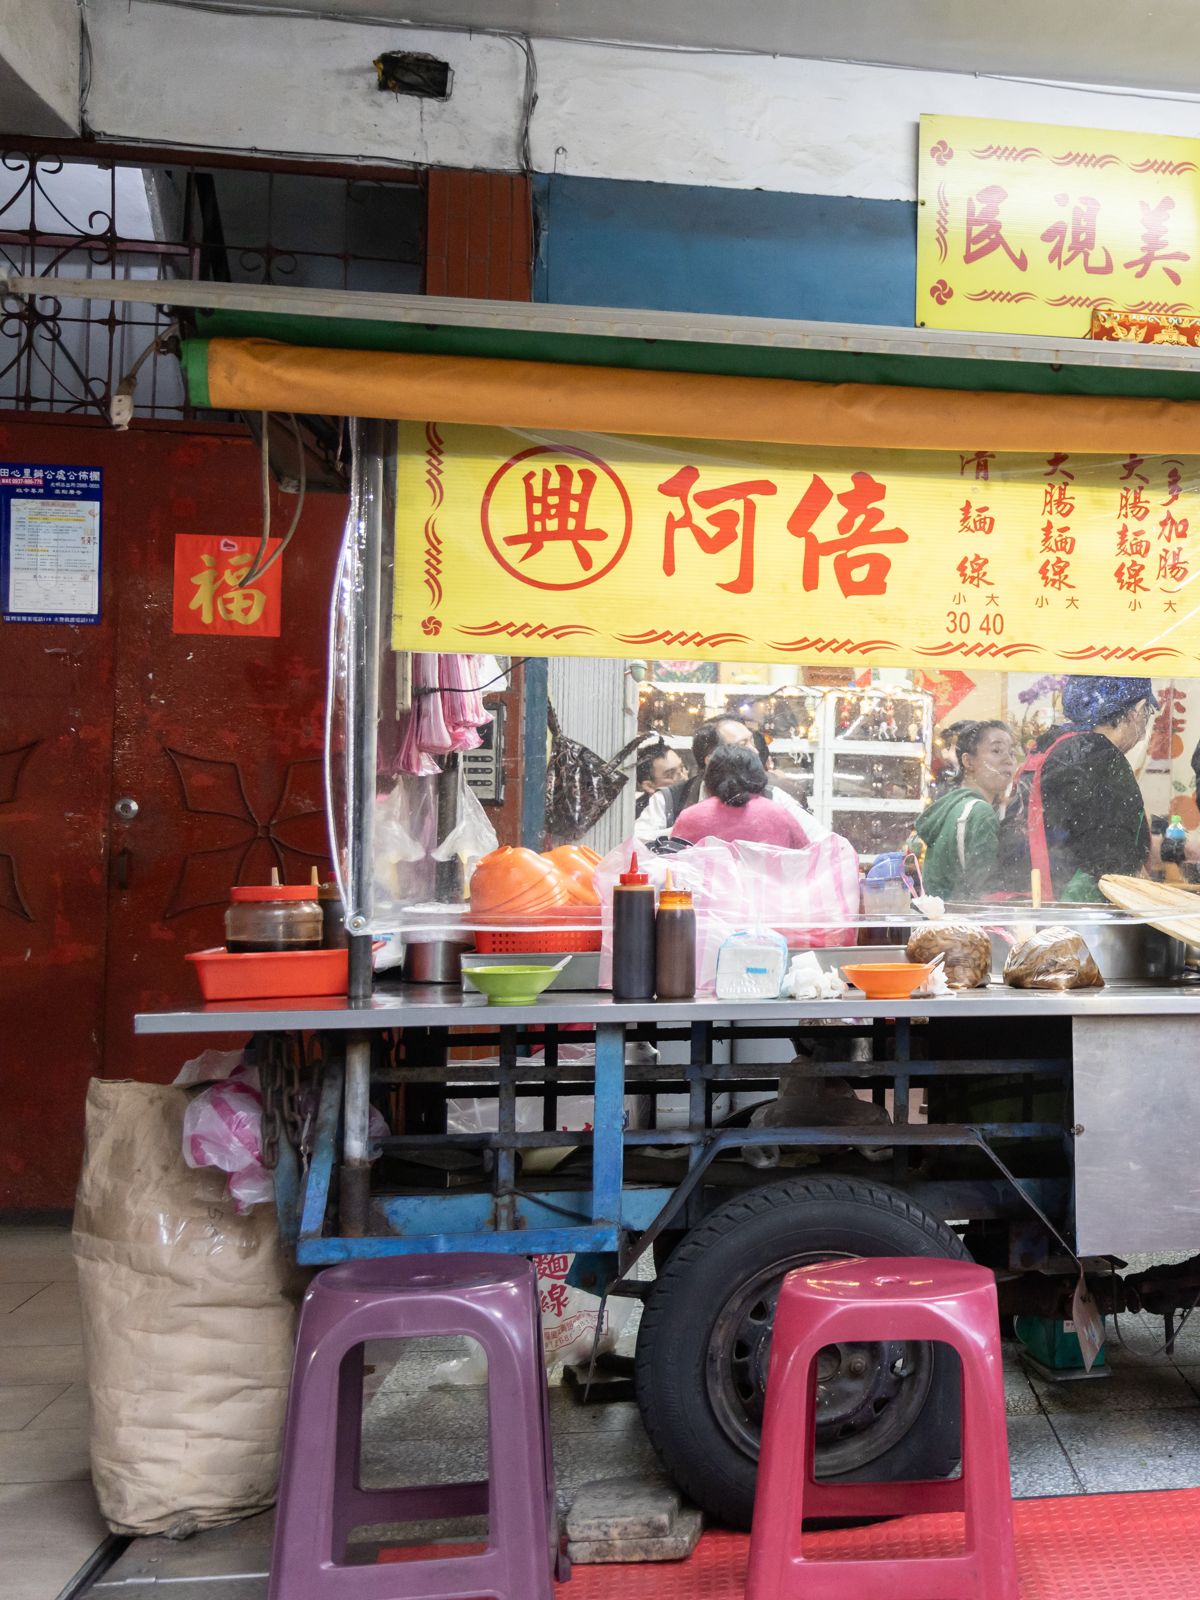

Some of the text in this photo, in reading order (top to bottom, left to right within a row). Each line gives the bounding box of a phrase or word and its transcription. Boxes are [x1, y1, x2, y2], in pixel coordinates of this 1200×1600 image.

[502, 464, 909, 599] 興 阿倍
[1038, 452, 1076, 591] 大腸麵線
[1114, 454, 1151, 593] 大腸麵線
[189, 553, 267, 625] 福
[952, 592, 1000, 606] 小 大
[1035, 595, 1080, 609] 小 大
[1128, 599, 1177, 613] 小 大
[946, 611, 1004, 635] 30 40
